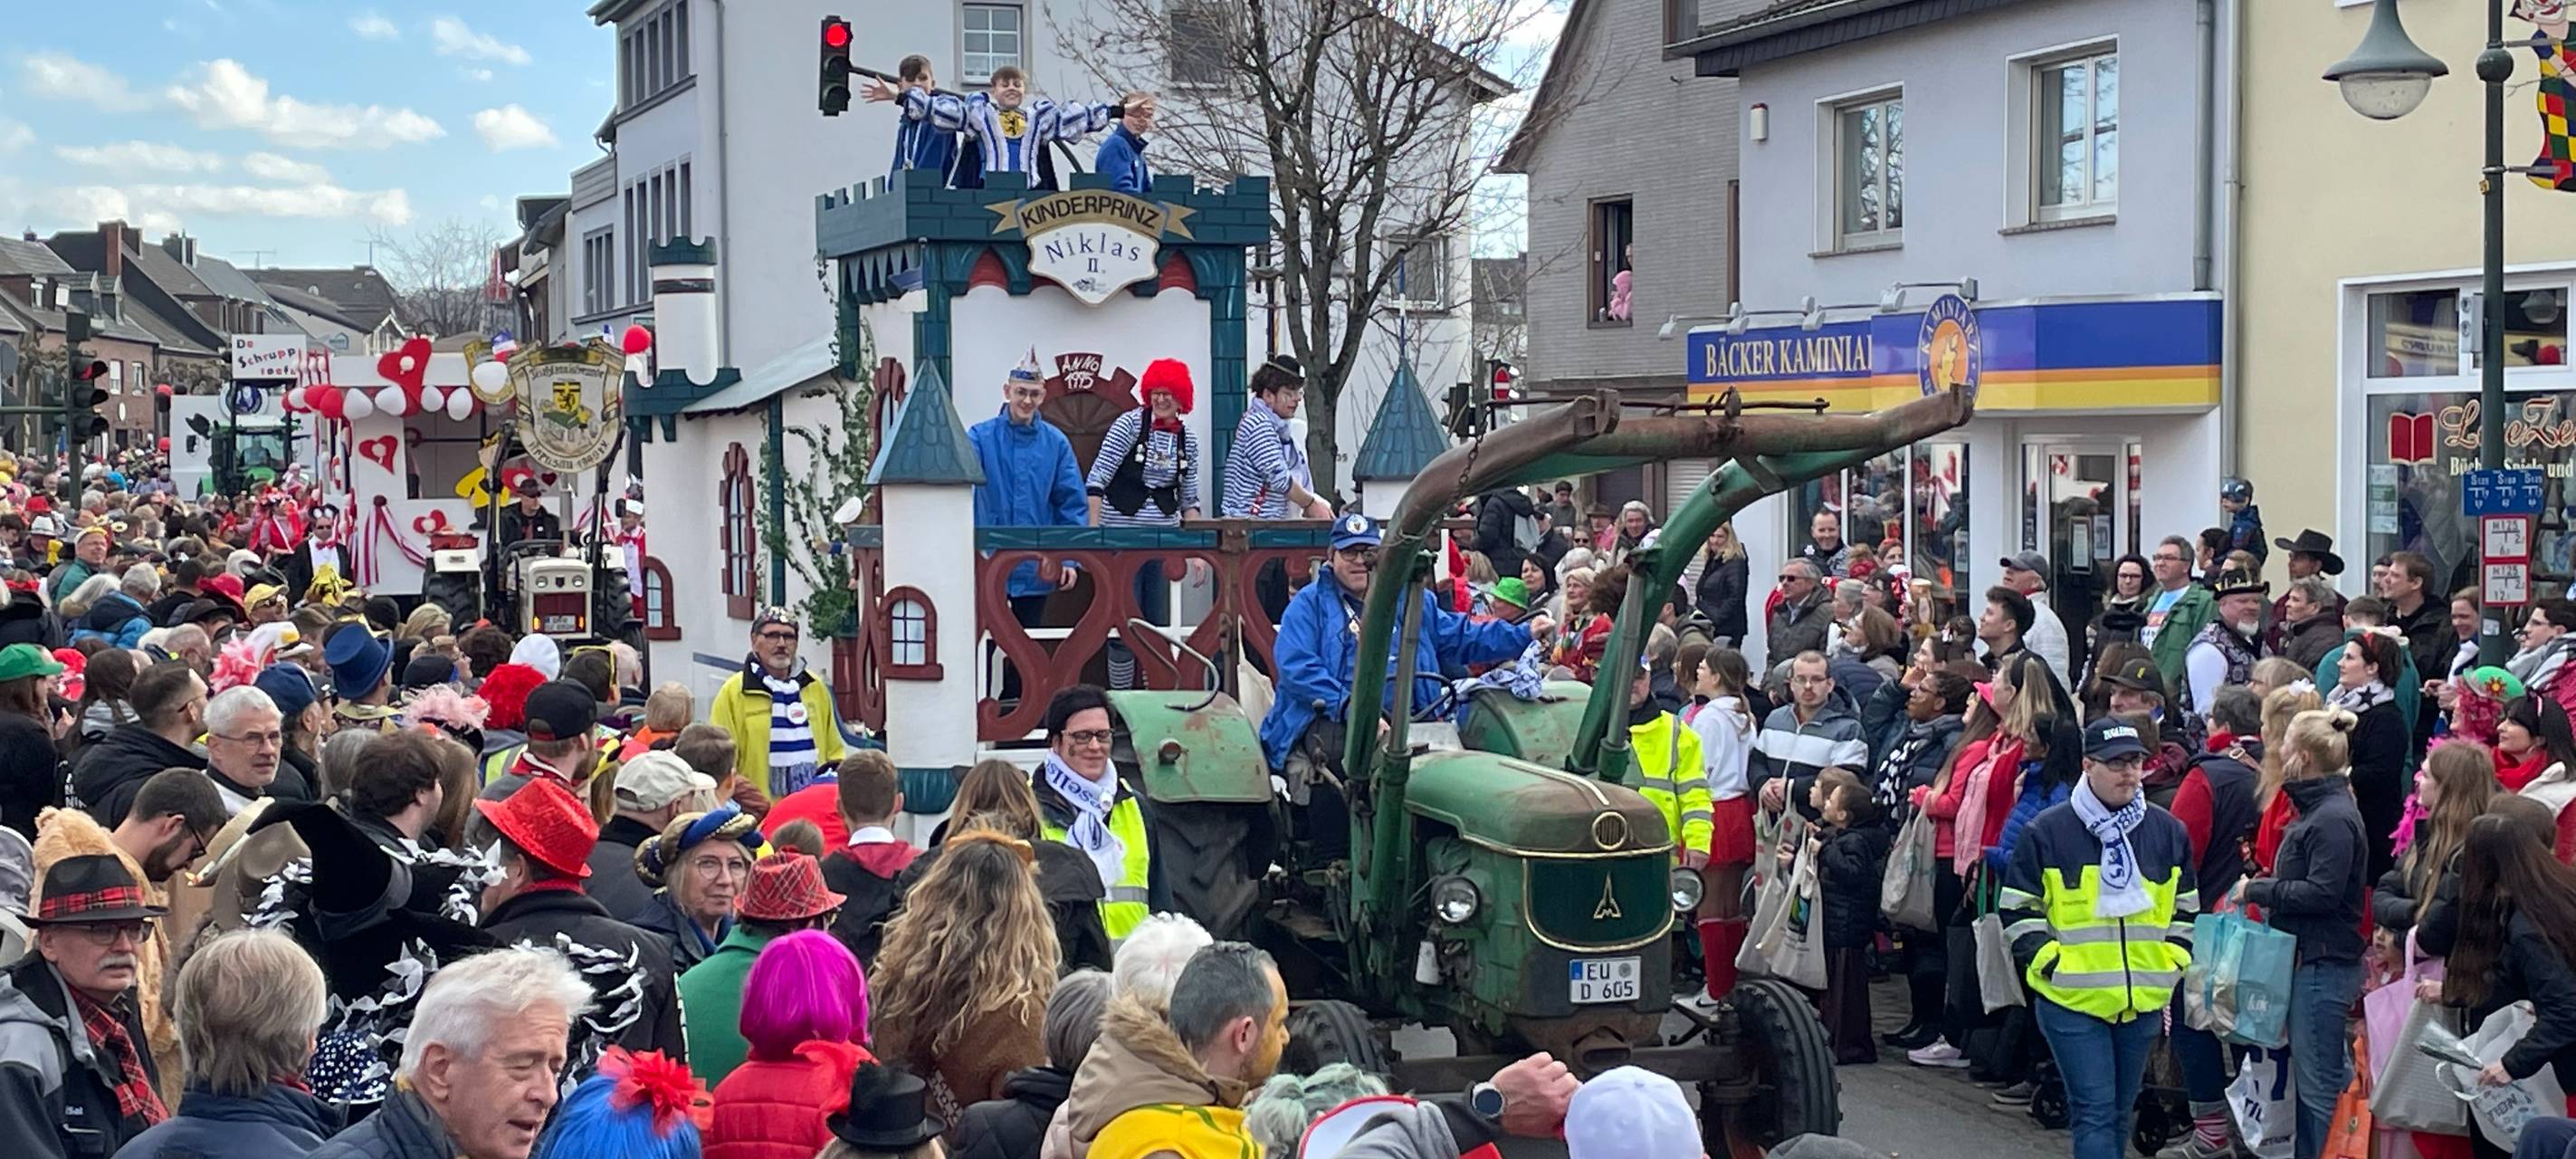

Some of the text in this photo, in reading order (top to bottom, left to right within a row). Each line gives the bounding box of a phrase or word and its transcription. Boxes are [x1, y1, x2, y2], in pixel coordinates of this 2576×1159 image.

[1021, 196, 1159, 229] KINDERPRINZ
[1045, 232, 1140, 263] Niklas
[236, 339, 253, 349] De
[1062, 354, 1099, 373] ANNO
[1705, 337, 1775, 377] BÄCKER
[1064, 370, 1094, 389] 1995
[2547, 456, 2574, 478] und
[1587, 963, 1610, 981] EU
[1580, 981, 1634, 1000] D 605
